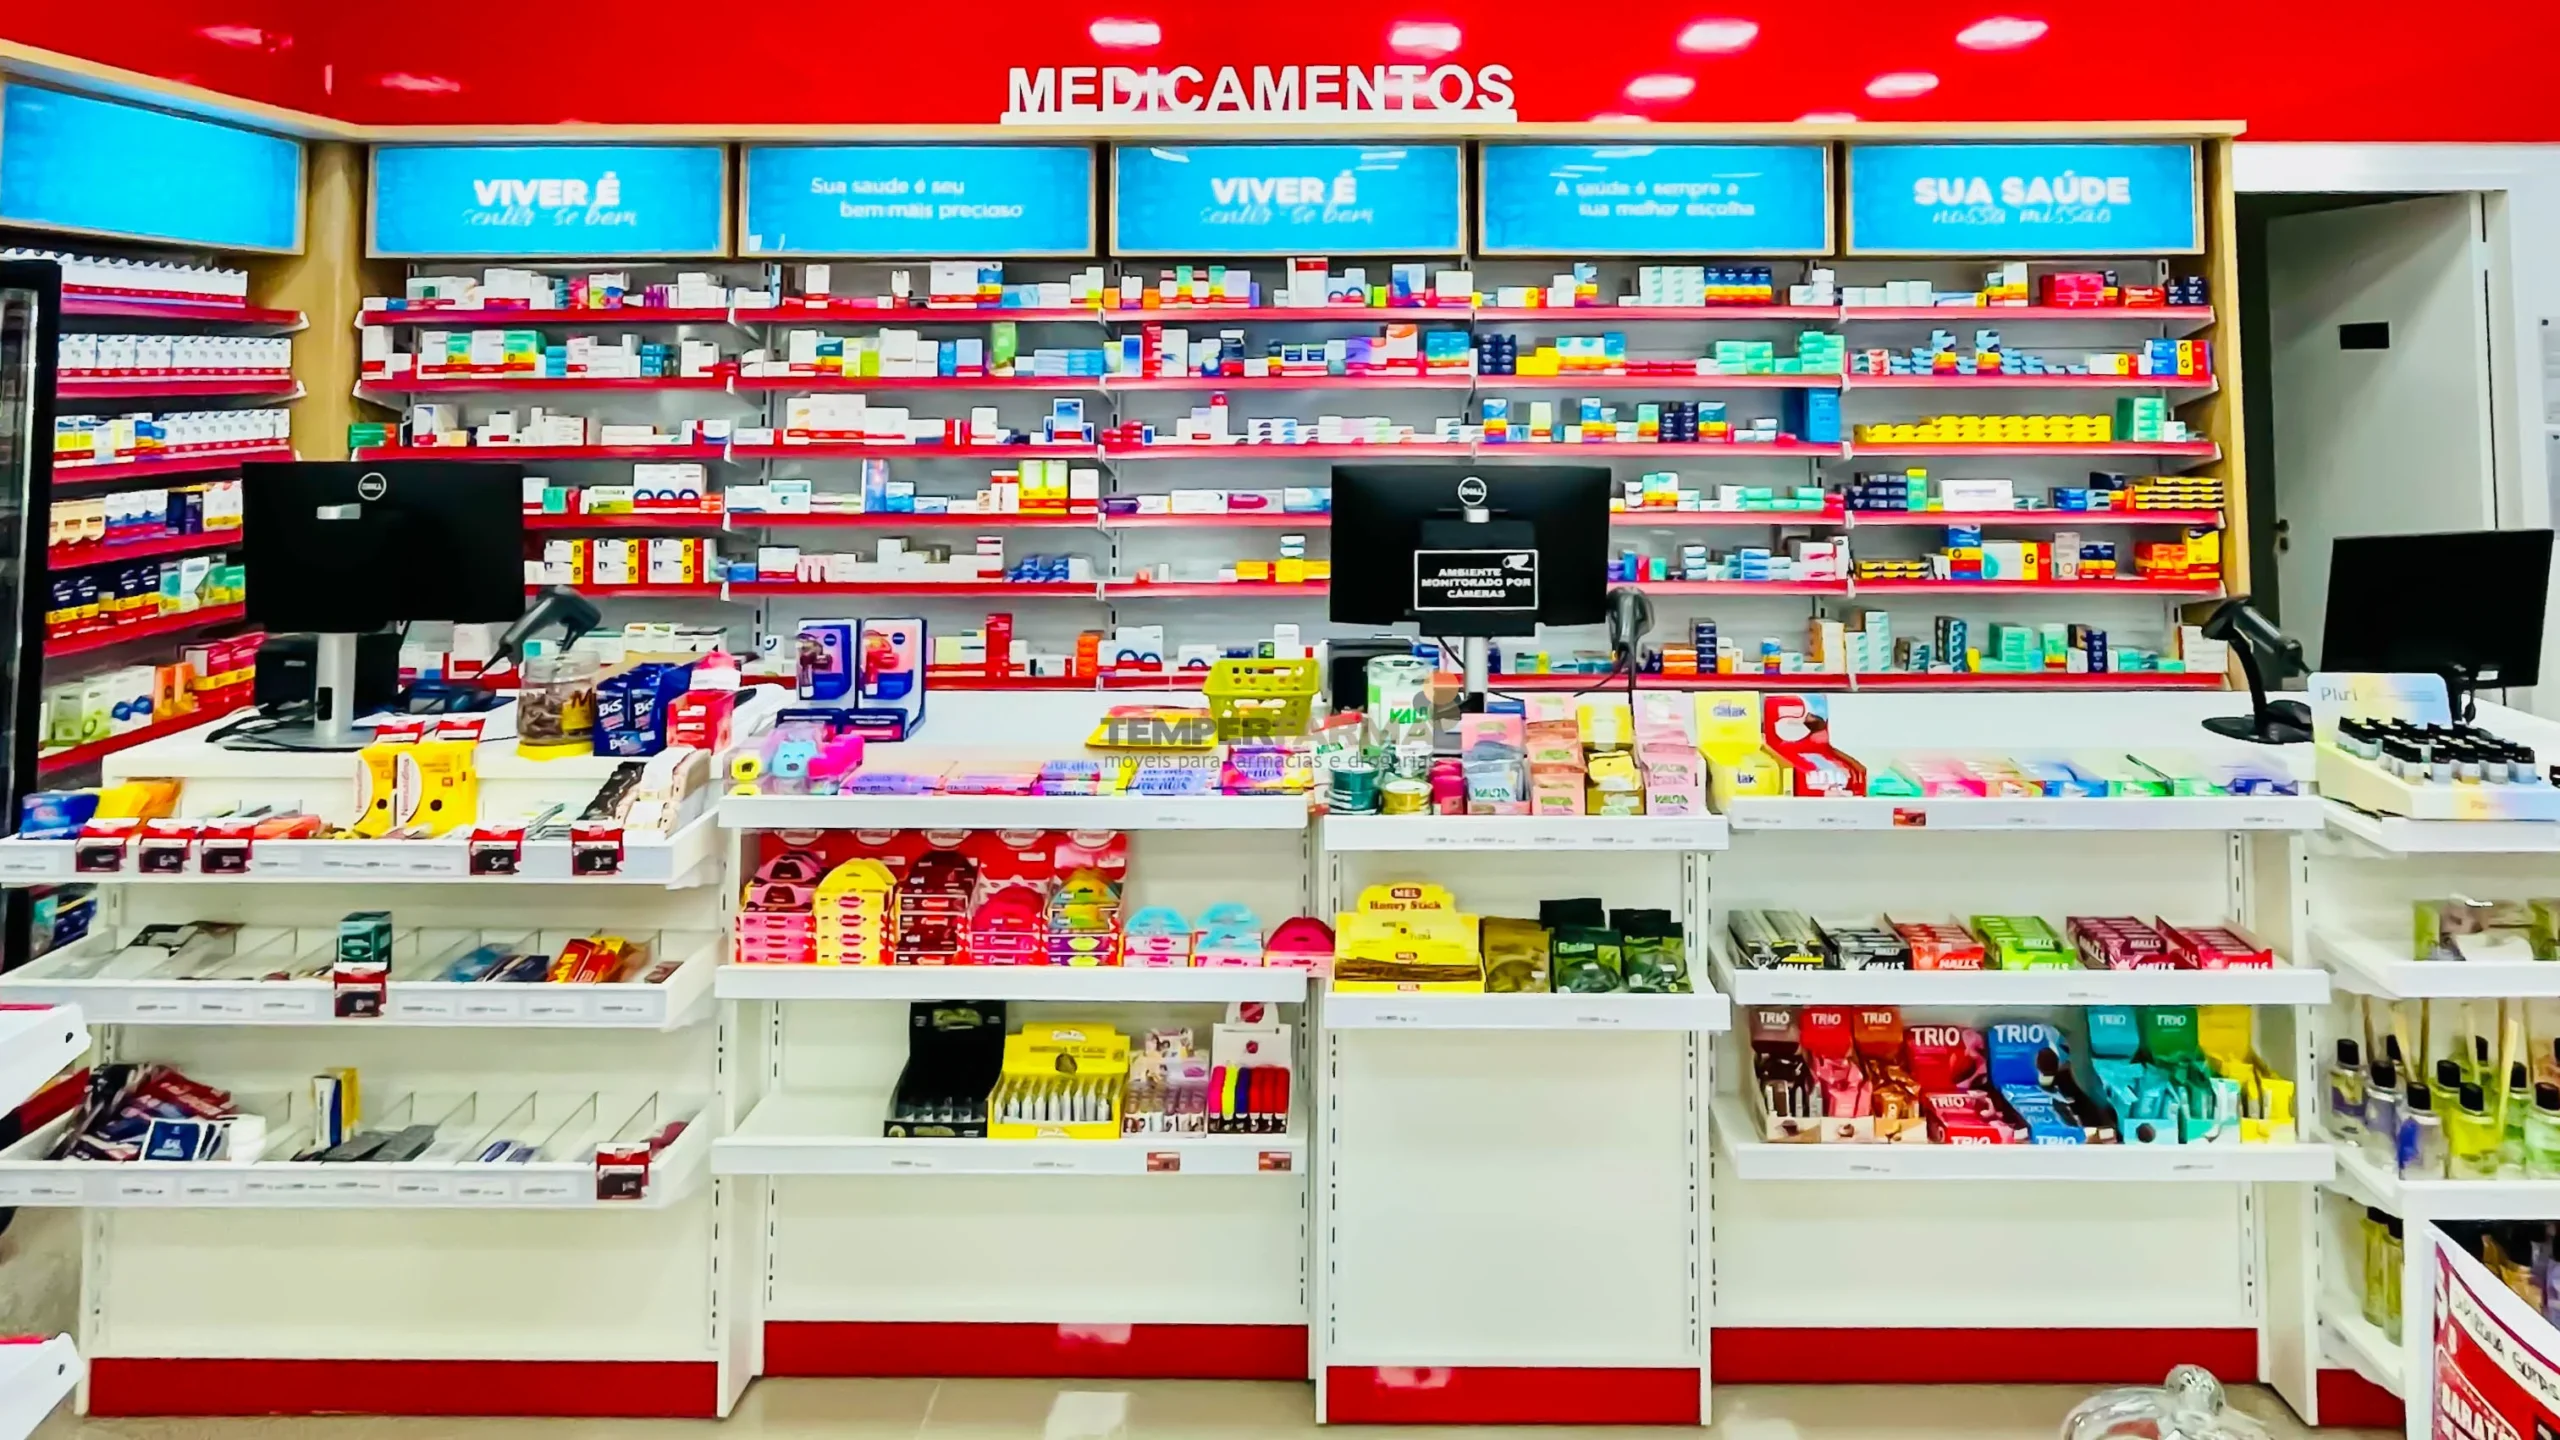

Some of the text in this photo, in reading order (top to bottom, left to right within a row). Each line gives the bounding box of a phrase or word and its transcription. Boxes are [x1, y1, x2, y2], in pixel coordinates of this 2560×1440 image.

[1008, 63, 1515, 113] MEDICAMENTOS
[473, 171, 620, 207] VIVER É
[811, 177, 847, 194] Sua
[931, 180, 965, 195] seu
[1210, 169, 1357, 205] VIVER É
[1555, 180, 1570, 196] A
[1913, 170, 2132, 206] SUA SAÚDE
[840, 200, 885, 218] bem
[938, 202, 1023, 220] precioso
[1579, 199, 1756, 218] sua melhor escolha
[1438, 568, 1502, 578] AMBIENTE
[1421, 578, 1532, 588] MONITORADO POR
[1447, 588, 1506, 599] CÂMERAS
[1393, 889, 1419, 898] MEL
[1369, 900, 1442, 912] Honey Stick
[1939, 959, 1981, 970] HALLS
[1759, 1011, 1791, 1025] TRIO
[1811, 1012, 1842, 1026] TRIO
[1862, 1011, 1893, 1025] TRIO
[2097, 1014, 2127, 1026] TRIO
[2156, 1014, 2187, 1027] TRIO
[1910, 1026, 1961, 1047] TRIO
[1994, 1024, 2044, 1044] TRIO
[1931, 1096, 1966, 1109] TRIO
[1951, 1135, 1992, 1145] TRIO
[2035, 1135, 2077, 1145] TRIO
